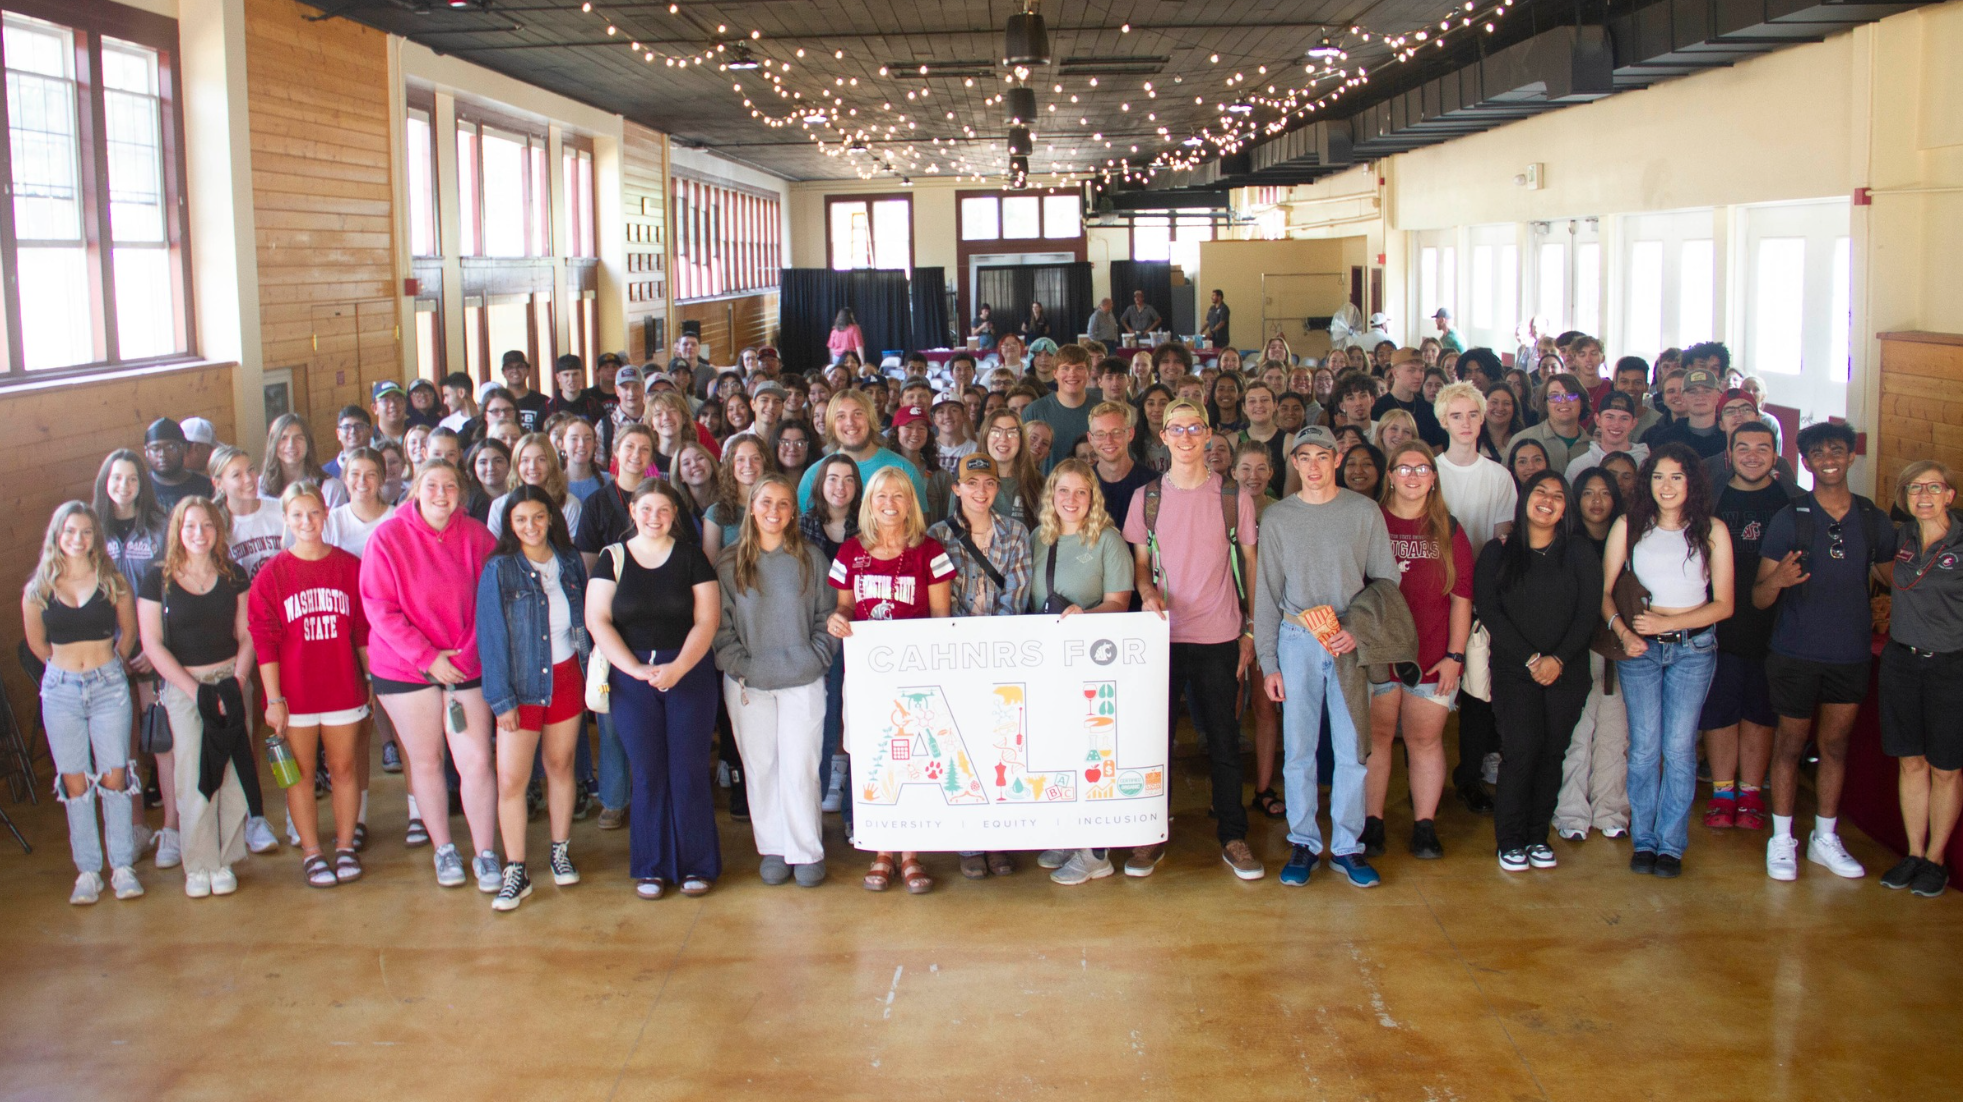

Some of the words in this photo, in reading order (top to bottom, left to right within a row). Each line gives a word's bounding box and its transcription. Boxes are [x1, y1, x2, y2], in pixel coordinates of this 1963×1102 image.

[1390, 539, 1440, 559] UGARS
[283, 587, 351, 624] WASHINGTON
[303, 614, 338, 641] STATE
[867, 640, 1044, 673] CAHNRS
[865, 820, 942, 829] DIVERSITY
[983, 819, 1037, 828] EQUITY
[1078, 812, 1158, 825] INCLUSION
